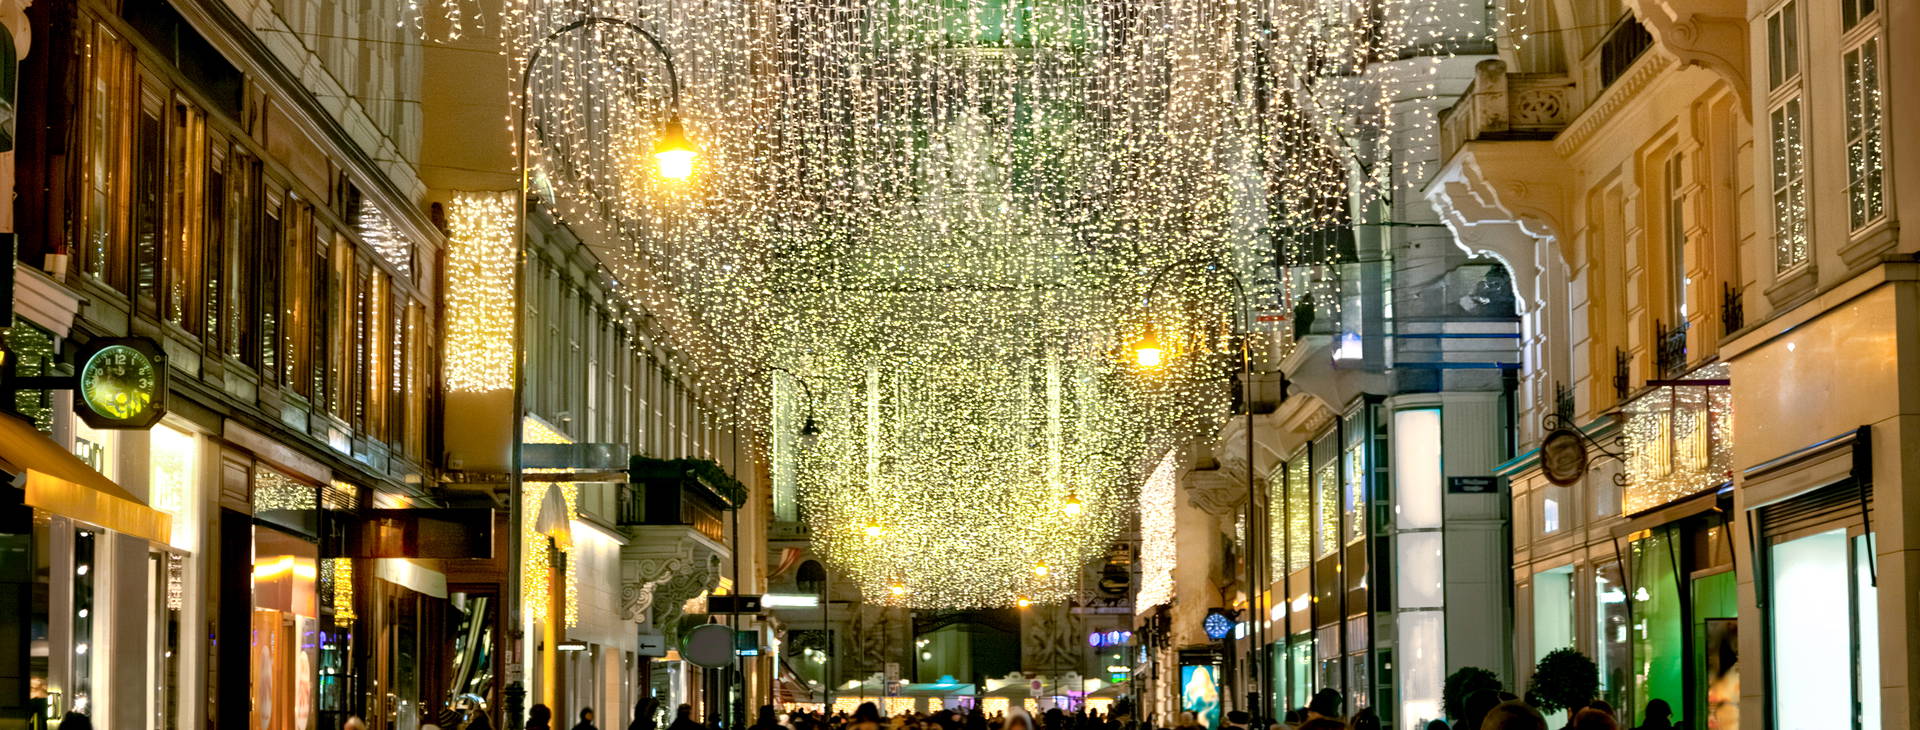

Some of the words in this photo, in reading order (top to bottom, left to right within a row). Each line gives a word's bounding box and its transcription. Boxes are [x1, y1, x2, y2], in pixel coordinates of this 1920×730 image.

[115, 354, 126, 365] 12
[138, 367, 145, 376] 2
[138, 378, 148, 389] 3
